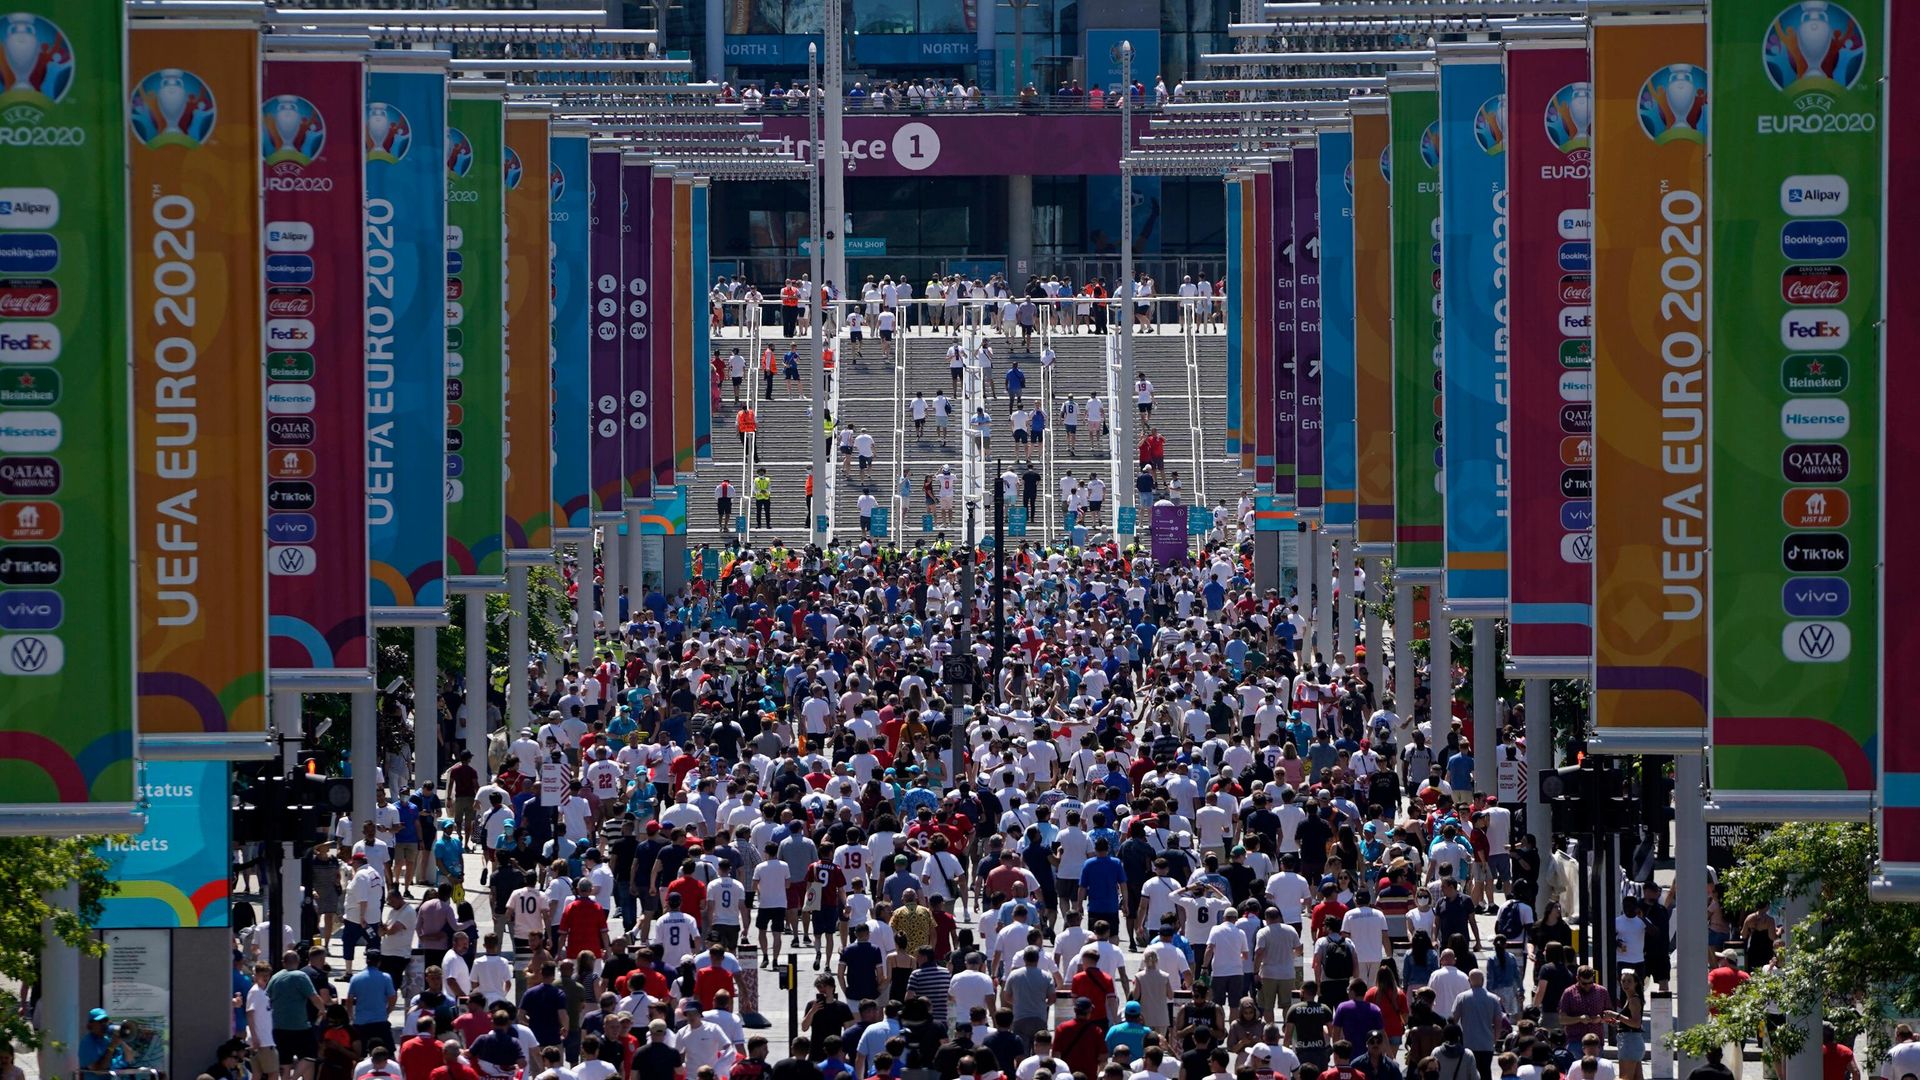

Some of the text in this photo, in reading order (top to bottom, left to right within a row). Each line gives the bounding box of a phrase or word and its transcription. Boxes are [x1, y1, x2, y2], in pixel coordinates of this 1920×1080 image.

[723, 44, 766, 55] NORTH
[923, 43, 968, 54] NORTH
[1757, 113, 1876, 134] EURO2020
[0, 127, 85, 146] RO2020
[910, 134, 924, 158] 1
[1541, 164, 1591, 180] EURO
[263, 177, 333, 192] URO2020
[448, 190, 479, 202] 2020
[1803, 190, 1841, 202] Alipay
[14, 202, 51, 215] Alipay
[1575, 219, 1591, 229] Alip
[281, 231, 308, 242] Alipay
[1784, 234, 1846, 246] Booking.com
[153, 195, 197, 328] 2020
[1560, 252, 1591, 261] Booking.
[1660, 190, 1703, 322] 2020
[267, 264, 312, 274] Booking.com
[1564, 315, 1591, 328] FedE
[271, 327, 308, 339] FedEx
[1789, 321, 1840, 338] FedEx
[0, 334, 51, 350] FedEx
[368, 198, 394, 526] UEFA EURO 2020
[271, 367, 310, 376] Heineken
[1562, 382, 1592, 390] Hisen
[1789, 376, 1842, 388] Heineken
[0, 389, 54, 401] Heineken
[269, 394, 313, 403] Hisense
[155, 337, 198, 479] EURO
[1661, 331, 1704, 474] EURO
[1564, 410, 1592, 422] QAT
[1786, 413, 1846, 425] Hisense
[0, 426, 56, 438] Hisense
[271, 422, 311, 434] QATAR
[1788, 452, 1841, 469] QATAR
[1, 464, 54, 481] QATAR
[1801, 466, 1843, 475] AIRWAYS
[1574, 480, 1592, 489] TikT
[281, 492, 312, 501] TikTok
[1570, 509, 1591, 520] viv
[1801, 515, 1832, 524] JUST EAT
[276, 522, 308, 532] vivo
[157, 488, 199, 627] UEFA
[1662, 482, 1704, 622] UEFA
[1802, 548, 1844, 560] TikTok
[15, 560, 57, 574] TikTok
[1795, 589, 1838, 603] vivo
[7, 603, 51, 616] vivo
[1268, 754, 1276, 769] 8
[598, 773, 612, 789] 22
[137, 782, 193, 797] status
[1710, 825, 1749, 836] ENTRANCE
[103, 836, 169, 852] Tickets
[917, 831, 929, 848] 6
[1710, 836, 1727, 847] THIS
[844, 851, 861, 869] 19
[818, 869, 829, 888] 9
[519, 896, 537, 914] 10
[721, 890, 731, 908] 9
[1197, 906, 1209, 924] 6
[670, 926, 680, 946] 8
[1295, 1005, 1325, 1015] STONE
